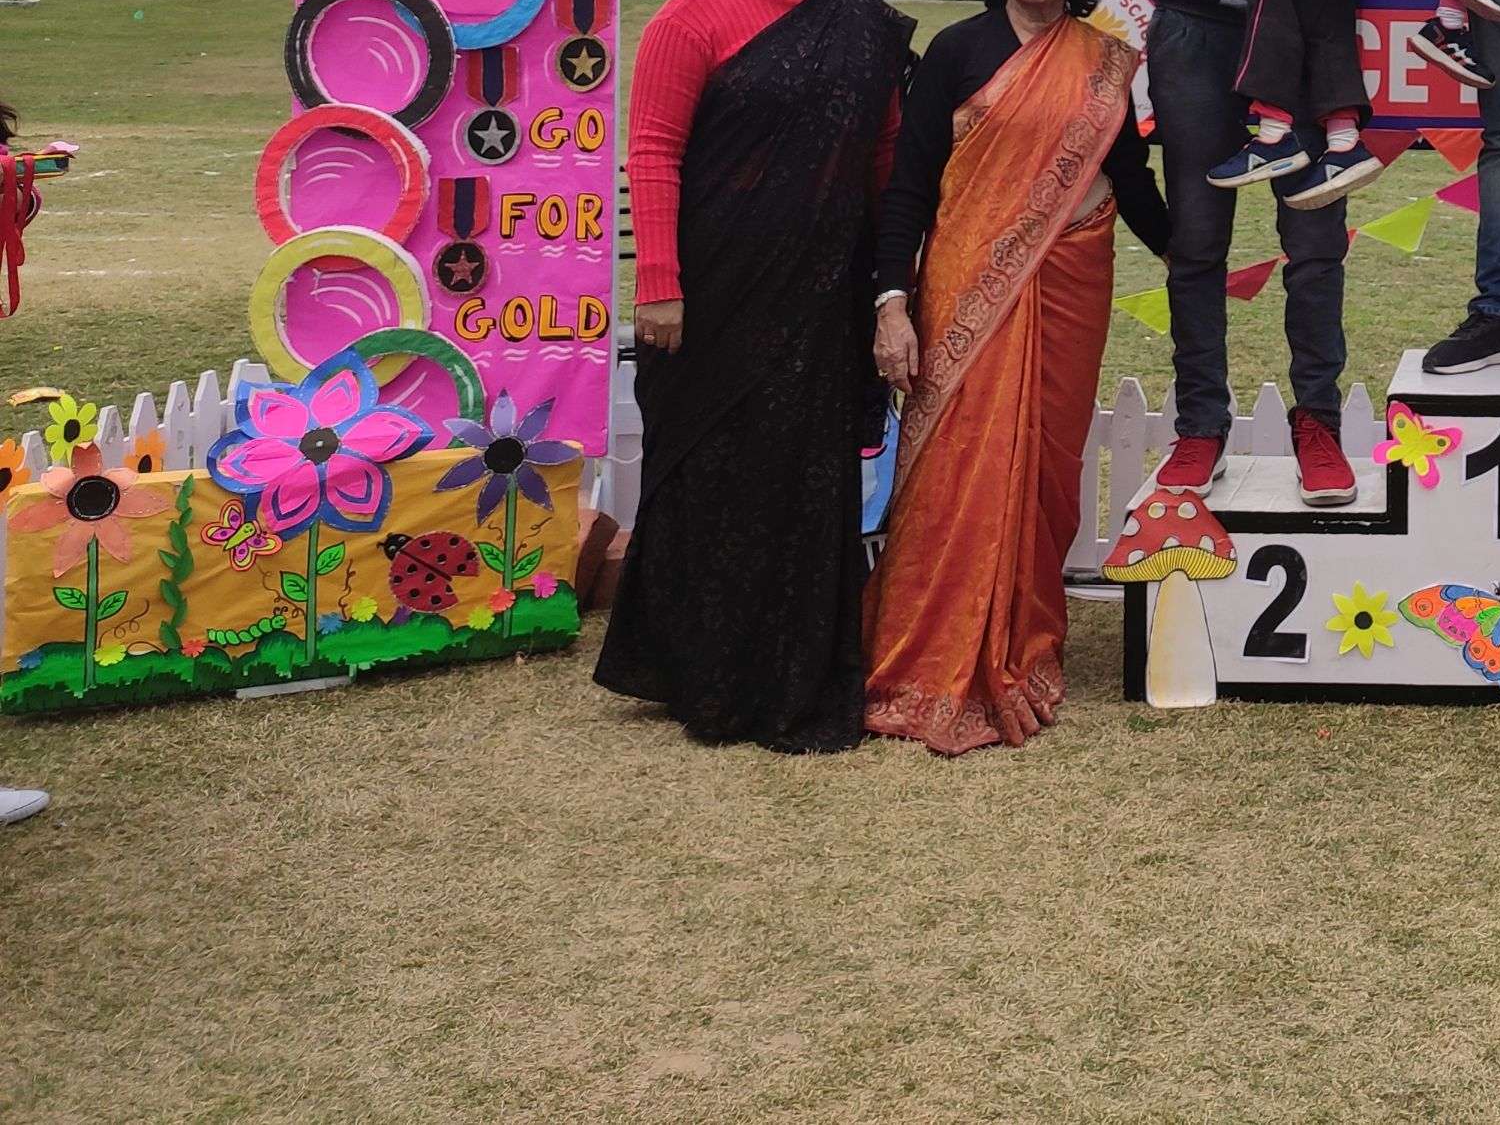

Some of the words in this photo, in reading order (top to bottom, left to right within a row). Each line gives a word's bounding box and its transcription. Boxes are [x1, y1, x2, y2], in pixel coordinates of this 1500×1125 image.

[529, 106, 606, 153] GO
[499, 192, 603, 242] FOR
[453, 295, 610, 342] GOLD
[1243, 544, 1309, 658] 2
